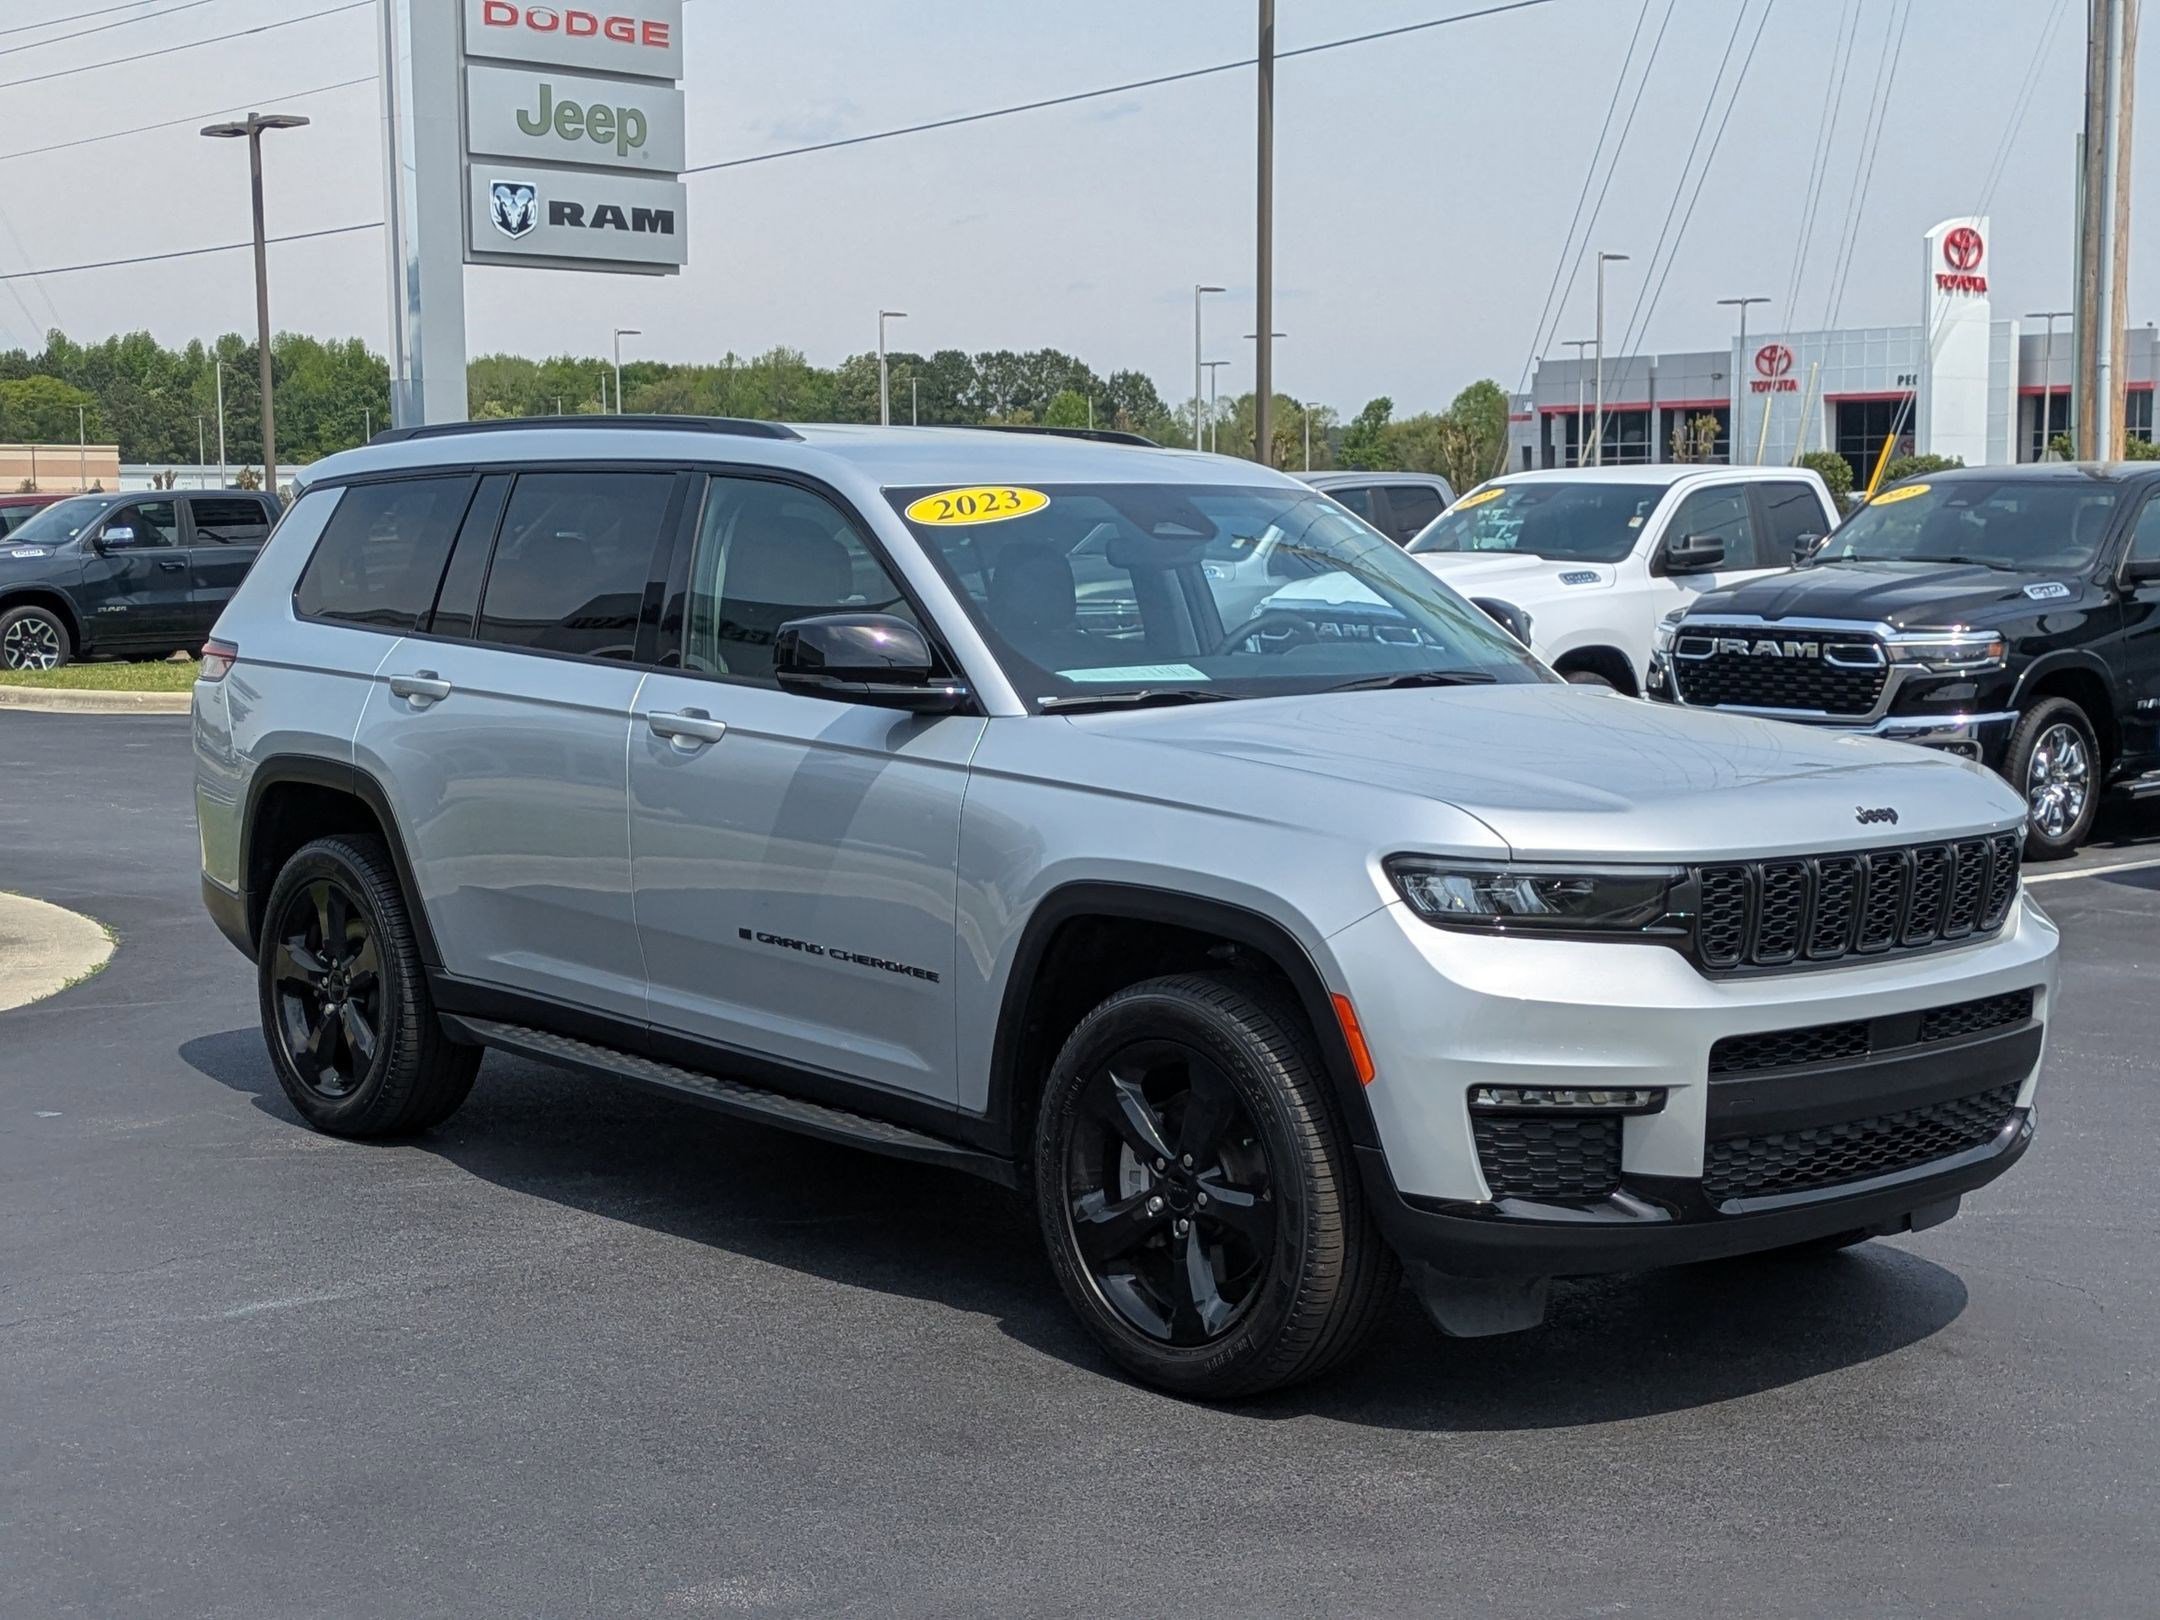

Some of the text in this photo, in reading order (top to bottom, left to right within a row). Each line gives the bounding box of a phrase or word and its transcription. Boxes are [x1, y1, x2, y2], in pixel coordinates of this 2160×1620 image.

[483, 0, 670, 48] DODGE
[516, 83, 647, 156] Jeep
[548, 200, 675, 235] RAM
[1935, 273, 1988, 293] TOYOTA
[932, 489, 1021, 521] 2023
[1719, 638, 1819, 658] RAM
[1855, 805, 1899, 825] Jeep
[756, 932, 940, 984] GRAND CHEROKEE
